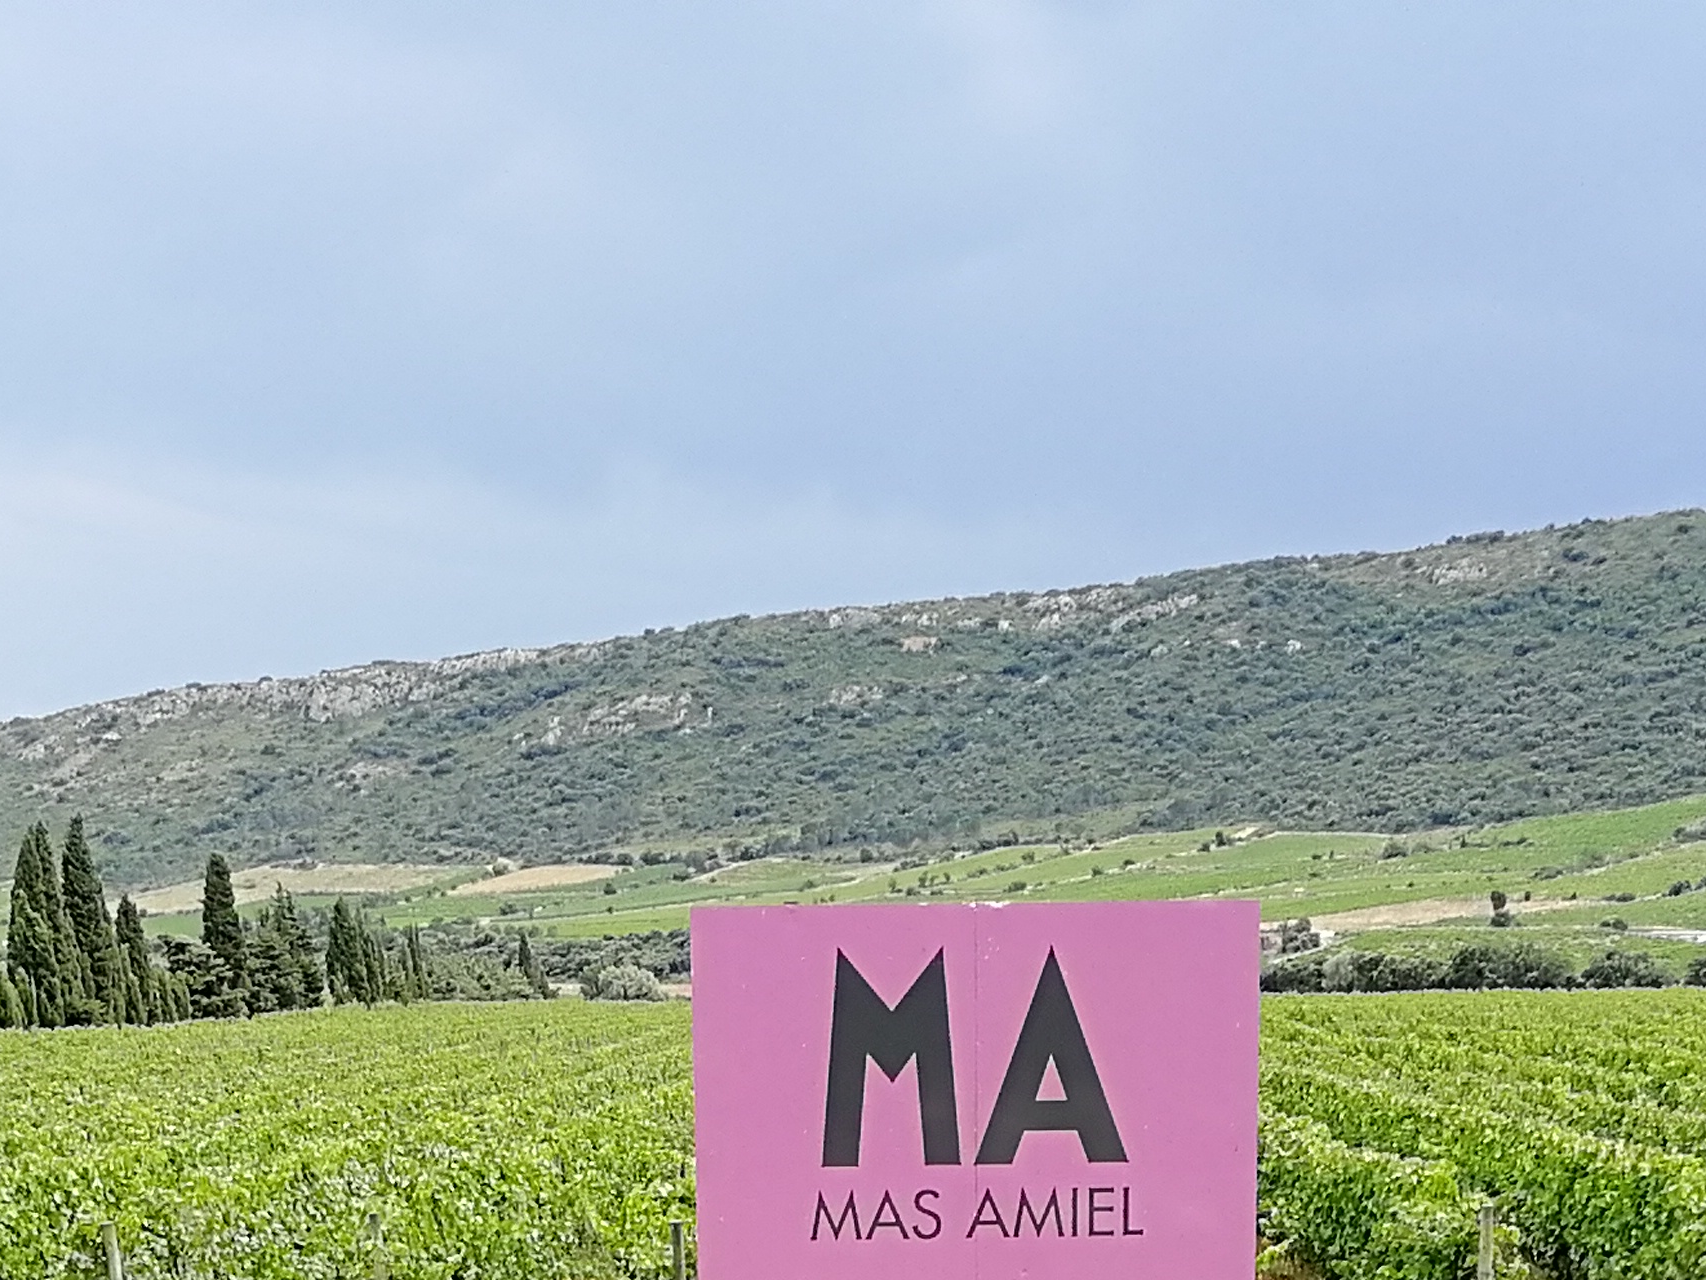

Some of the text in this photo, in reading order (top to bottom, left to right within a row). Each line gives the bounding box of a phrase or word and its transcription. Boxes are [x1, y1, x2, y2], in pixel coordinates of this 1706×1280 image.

[821, 944, 1130, 1168] MA
[810, 1186, 1144, 1241] MAS AMIEL
